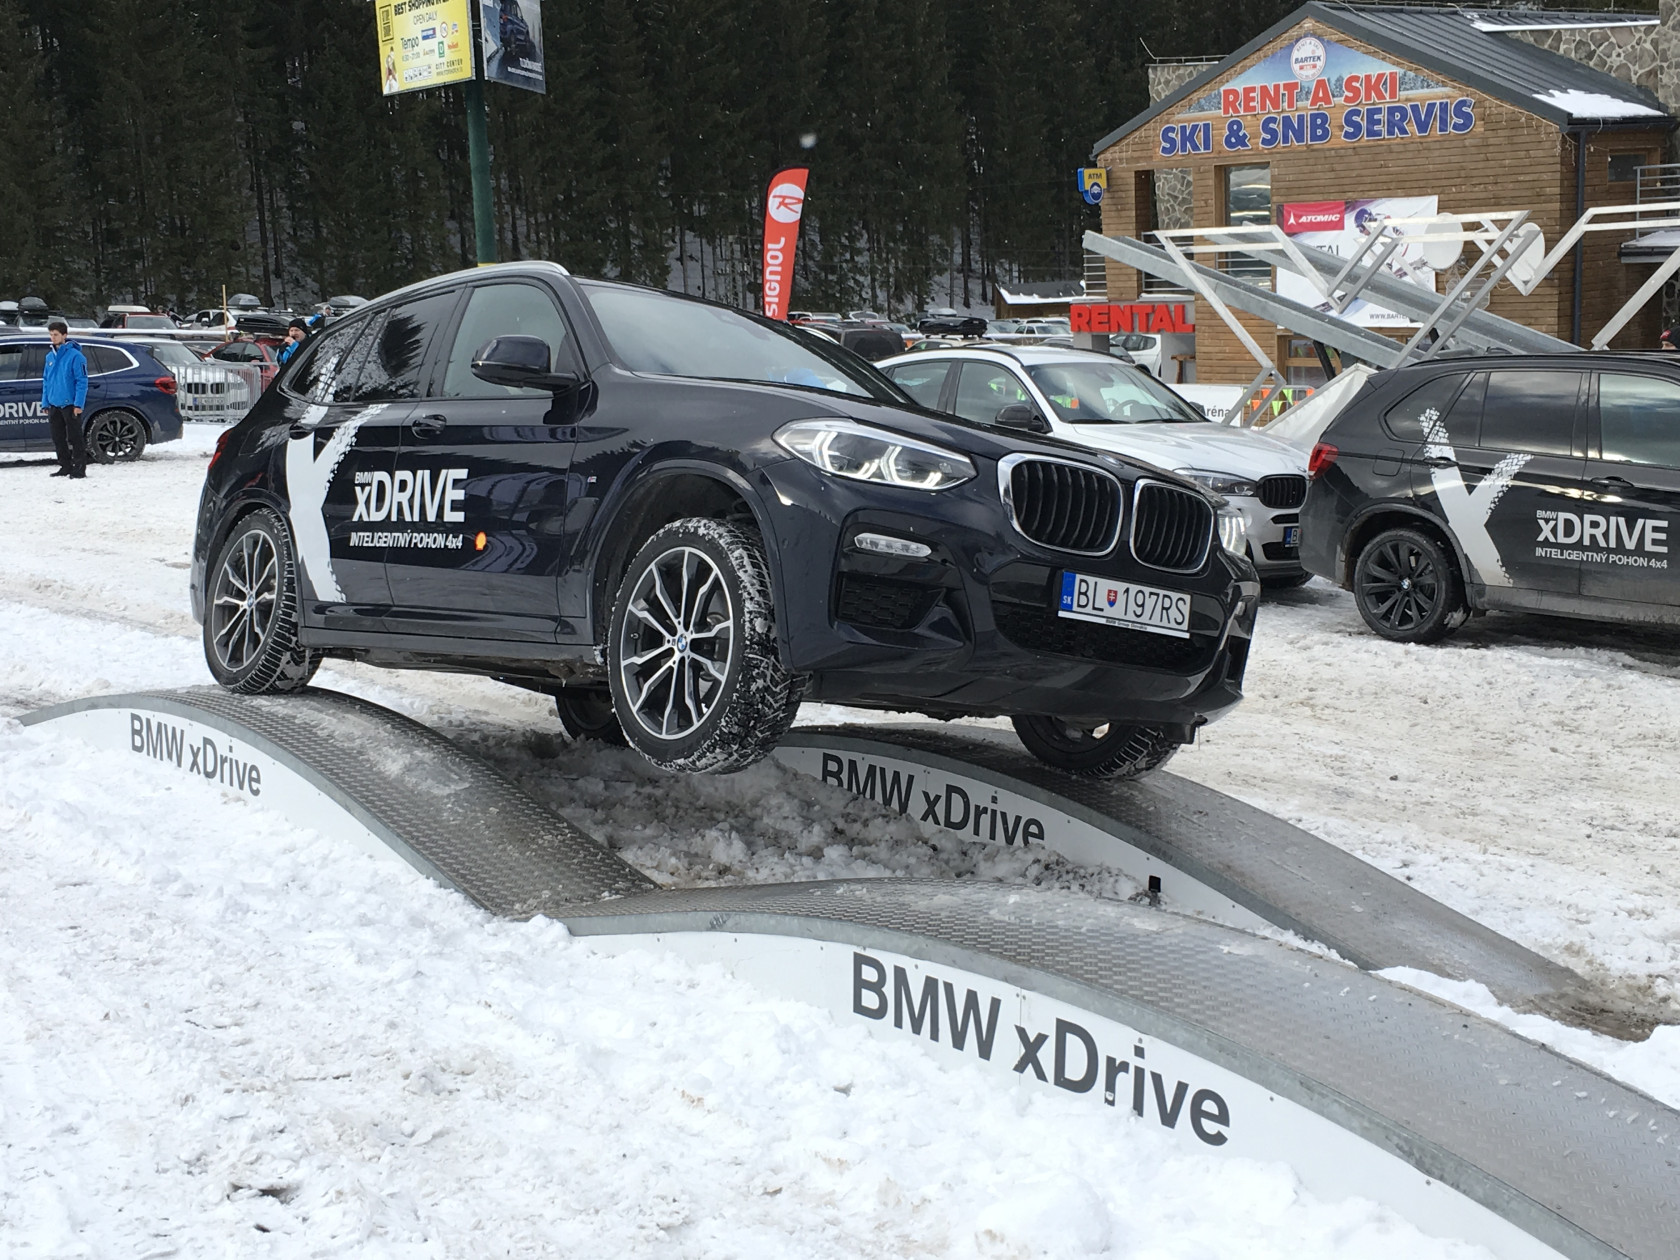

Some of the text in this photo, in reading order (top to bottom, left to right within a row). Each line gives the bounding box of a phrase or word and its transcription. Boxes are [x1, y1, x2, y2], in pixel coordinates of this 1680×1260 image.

[394, 1, 407, 16] BEST
[413, 10, 438, 25] OPEN DAILY
[401, 36, 419, 51] Tempo
[446, 58, 463, 68] CENTER
[1294, 55, 1322, 64] BARTEK
[1221, 70, 1399, 117] RENT A SKI
[1159, 97, 1476, 156] SKI & SNB SERVIS
[1087, 172, 1103, 180] ATM
[1298, 213, 1341, 223] ATOMIC
[1070, 304, 1195, 333] RENTAL
[1204, 405, 1231, 417] réna
[354, 471, 374, 484] BMW
[352, 468, 469, 522] xDRIVE
[1536, 509, 1558, 520] BMW
[349, 529, 463, 549] INTELIGENTNÝ POHON 4x4
[1536, 511, 1669, 554] xDRIVE
[1535, 546, 1668, 569] INTELIGENTNÝ POHON 4x4
[1062, 595, 1072, 605] SK
[1076, 578, 1187, 626] BL 197RS
[1117, 620, 1130, 628] Group
[130, 712, 262, 797] BMW xDrive
[821, 752, 1045, 847] BMW xDrive
[852, 951, 1231, 1147] BMW xDrive
